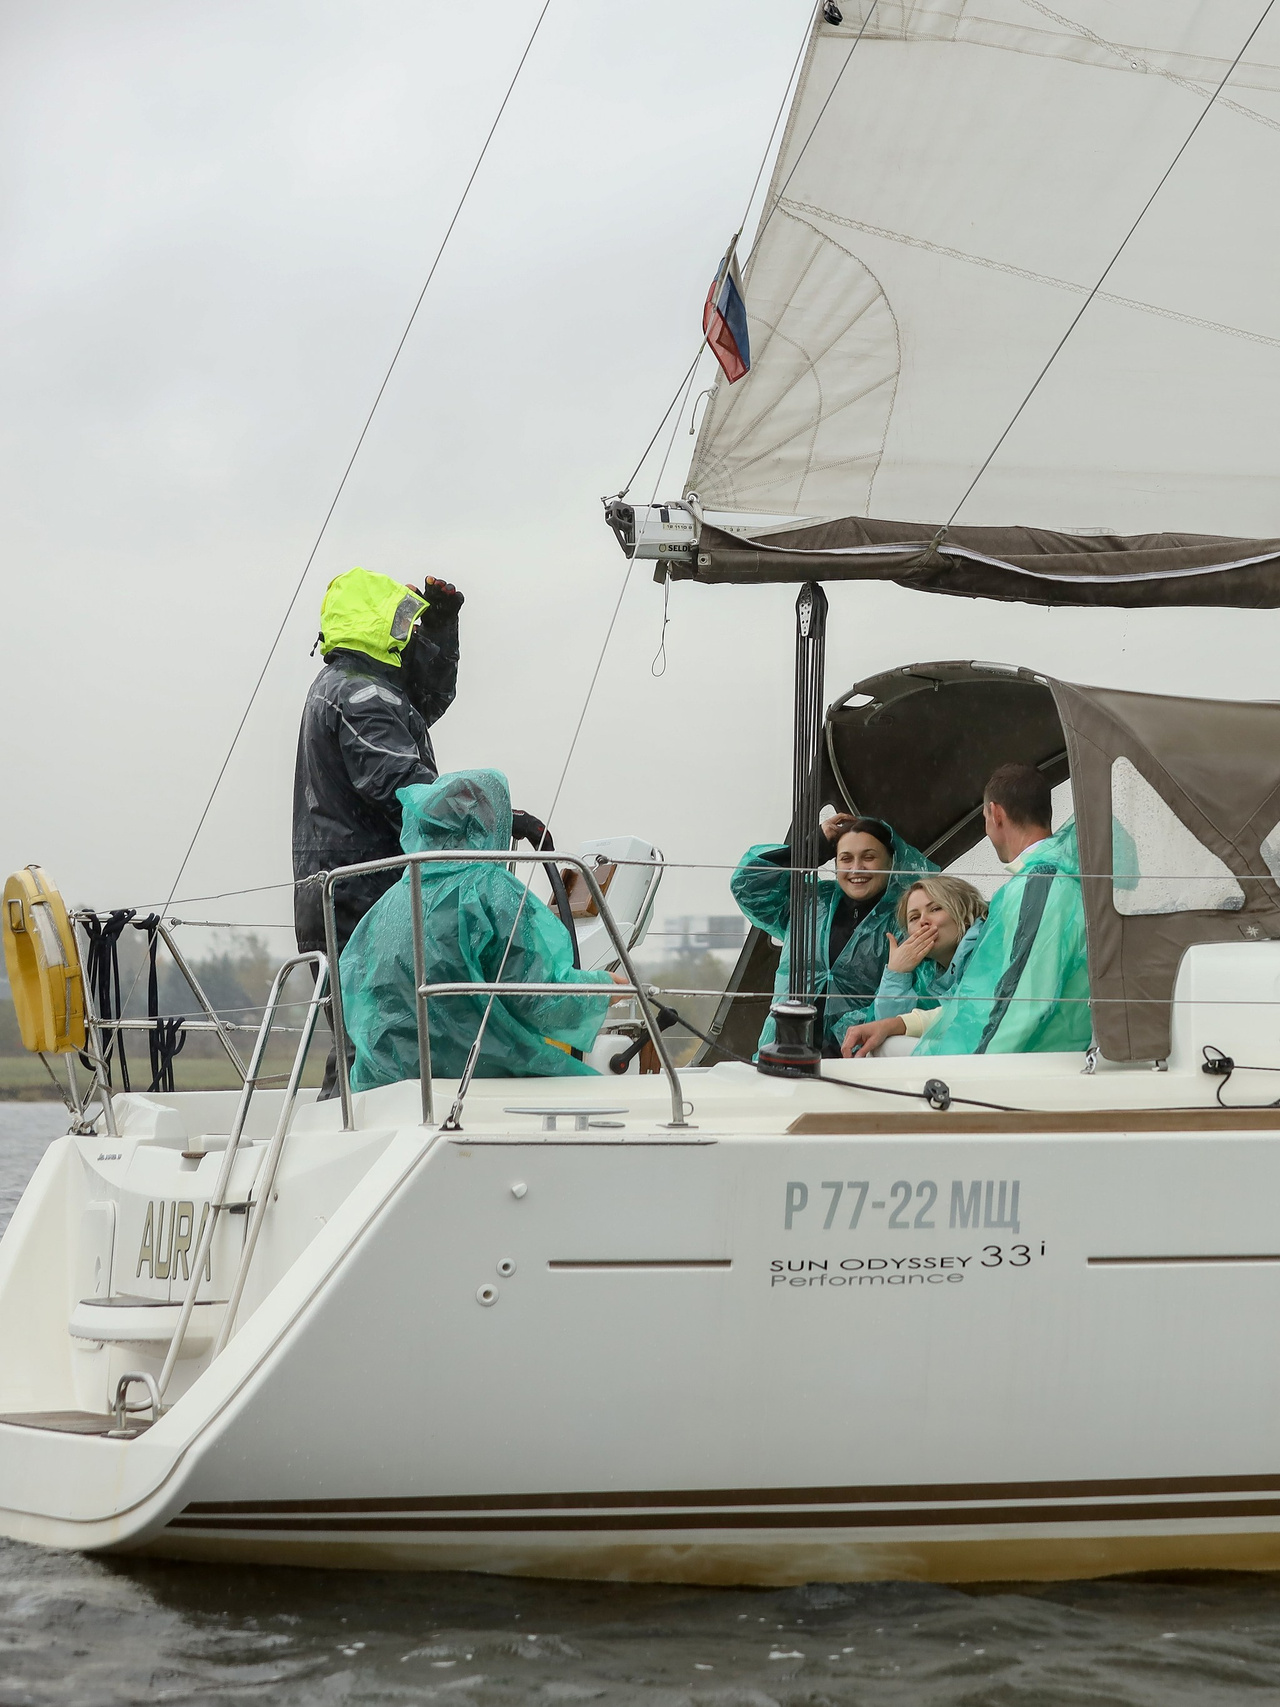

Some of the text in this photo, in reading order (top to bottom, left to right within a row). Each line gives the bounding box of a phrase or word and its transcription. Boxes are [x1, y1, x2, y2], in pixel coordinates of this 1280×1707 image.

[668, 544, 692, 552] SELD
[821, 1180, 938, 1230] 77-22
[949, 1180, 1021, 1235] МЩ
[136, 1200, 211, 1282] AURA
[769, 1259, 829, 1272] SUN
[840, 1256, 973, 1271] ODYSSEY
[771, 1273, 965, 1288] Performance
